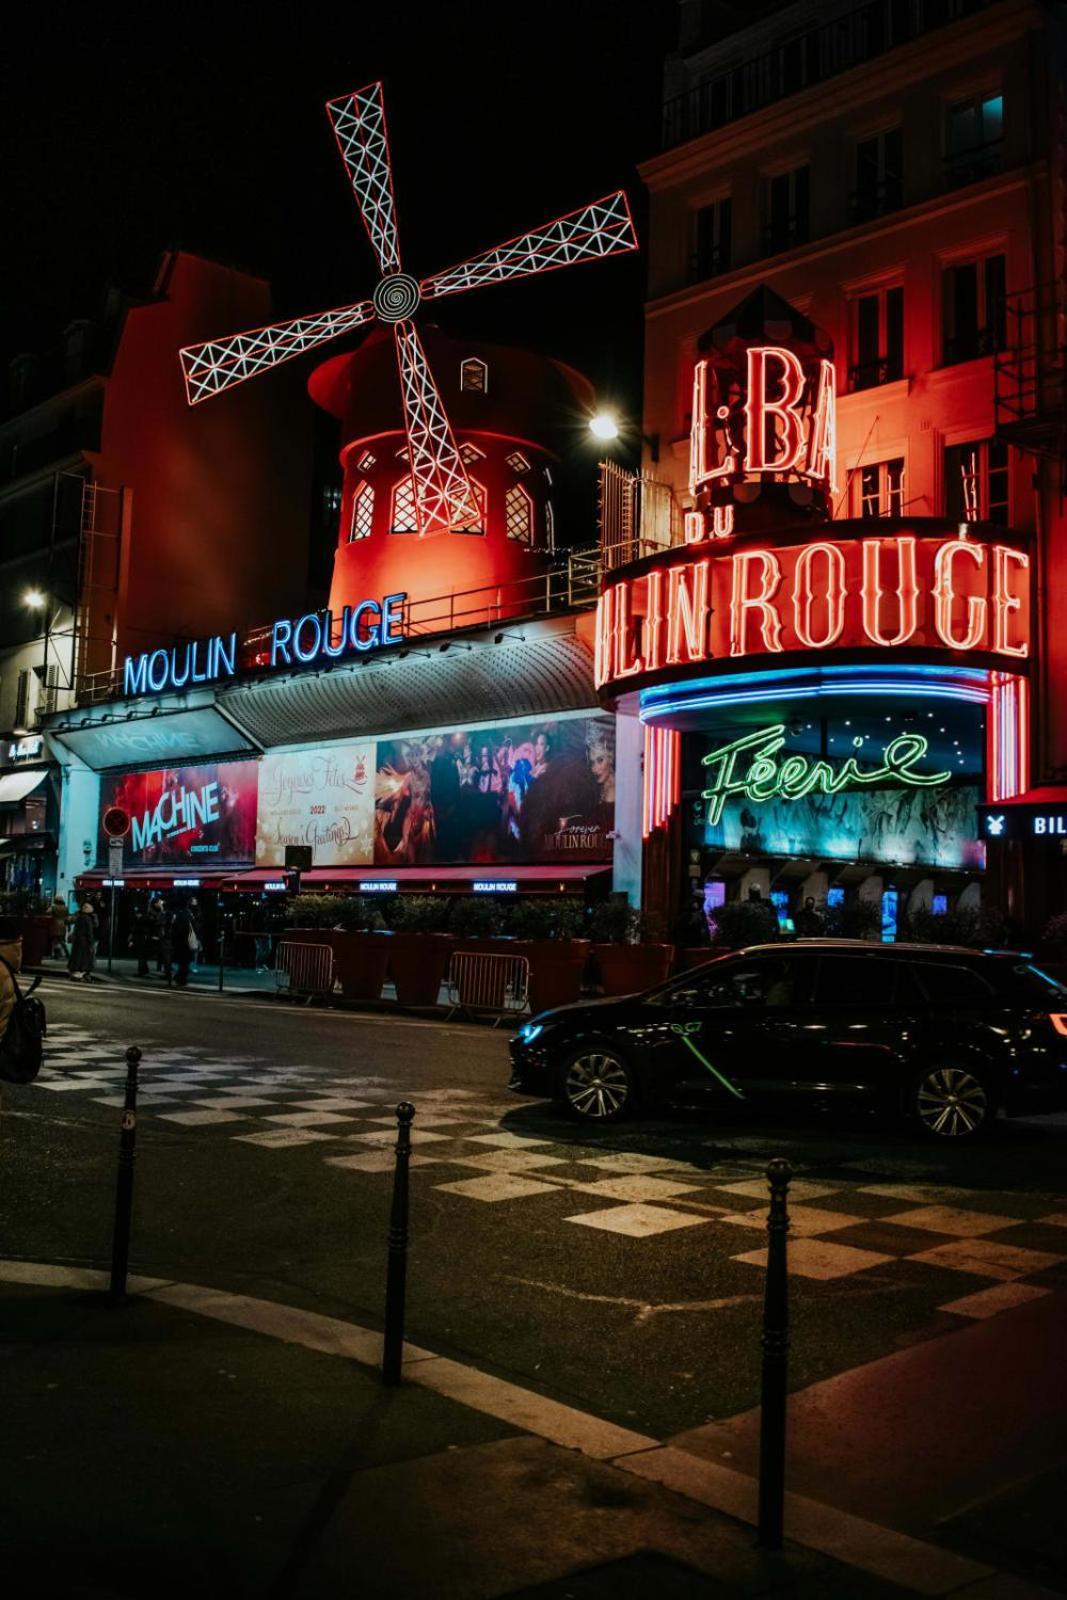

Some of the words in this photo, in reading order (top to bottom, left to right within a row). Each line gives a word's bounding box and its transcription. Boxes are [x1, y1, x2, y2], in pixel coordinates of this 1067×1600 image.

[684, 504, 735, 544] DU
[729, 536, 1031, 659] ROUGE
[123, 631, 237, 695] MOULIN
[270, 592, 408, 667] ROUGE
[131, 781, 220, 852] MACHINE
[309, 804, 326, 816] 2022
[700, 723, 952, 826] Féerie
